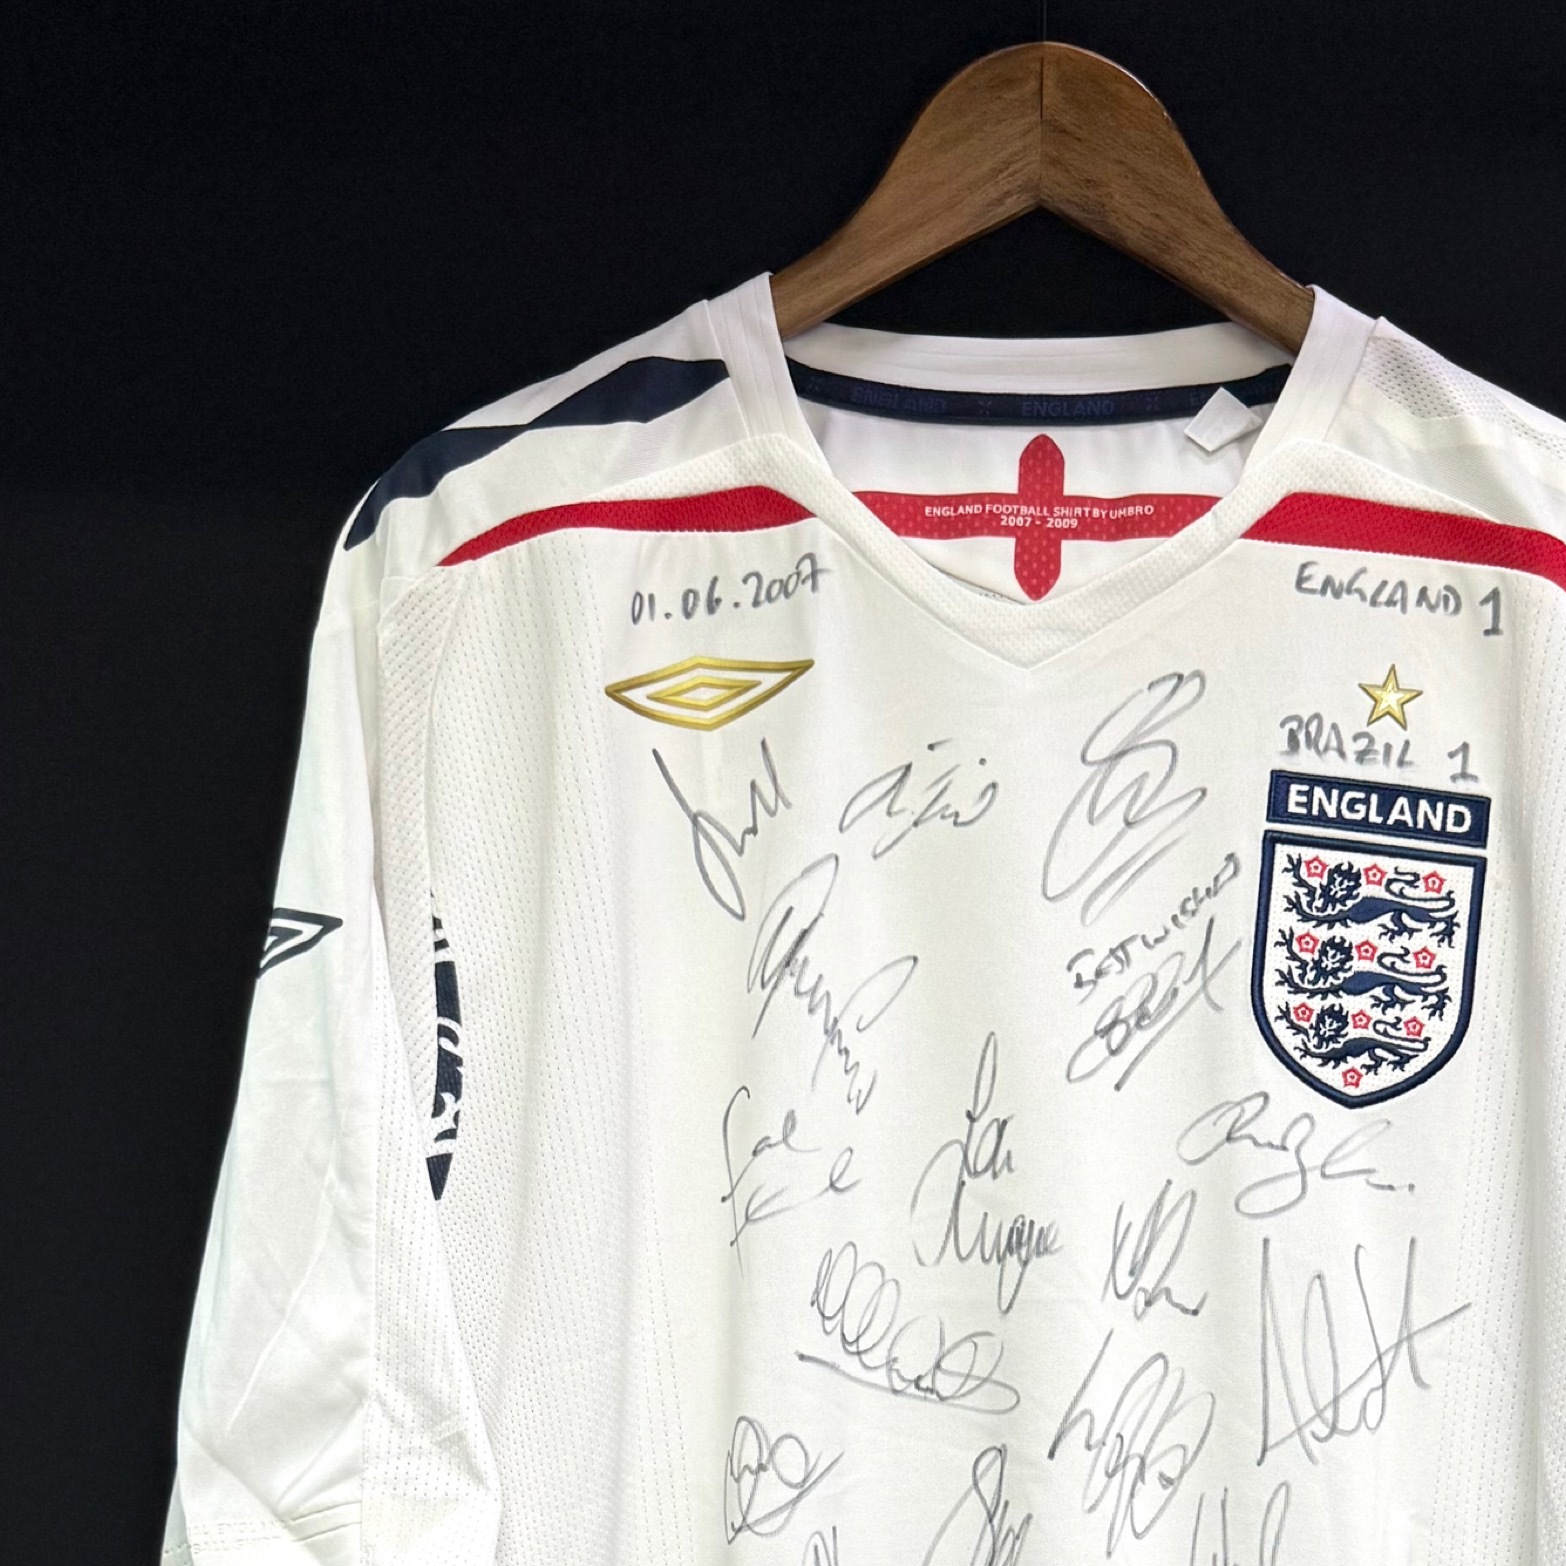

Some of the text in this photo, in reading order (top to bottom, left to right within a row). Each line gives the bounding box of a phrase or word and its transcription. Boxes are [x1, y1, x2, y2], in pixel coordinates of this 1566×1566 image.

[1022, 400, 1115, 417] ENGLAND
[925, 504, 1155, 519] ENGLAND FOOTBALL SHIRT BY UMBRO
[1000, 516, 1031, 527] 2007
[1046, 518, 1079, 529] 2009
[1294, 561, 1504, 637] ENGLAND 1
[1279, 711, 1479, 783] BRAZIL 1
[1286, 783, 1472, 834] ENGLAND
